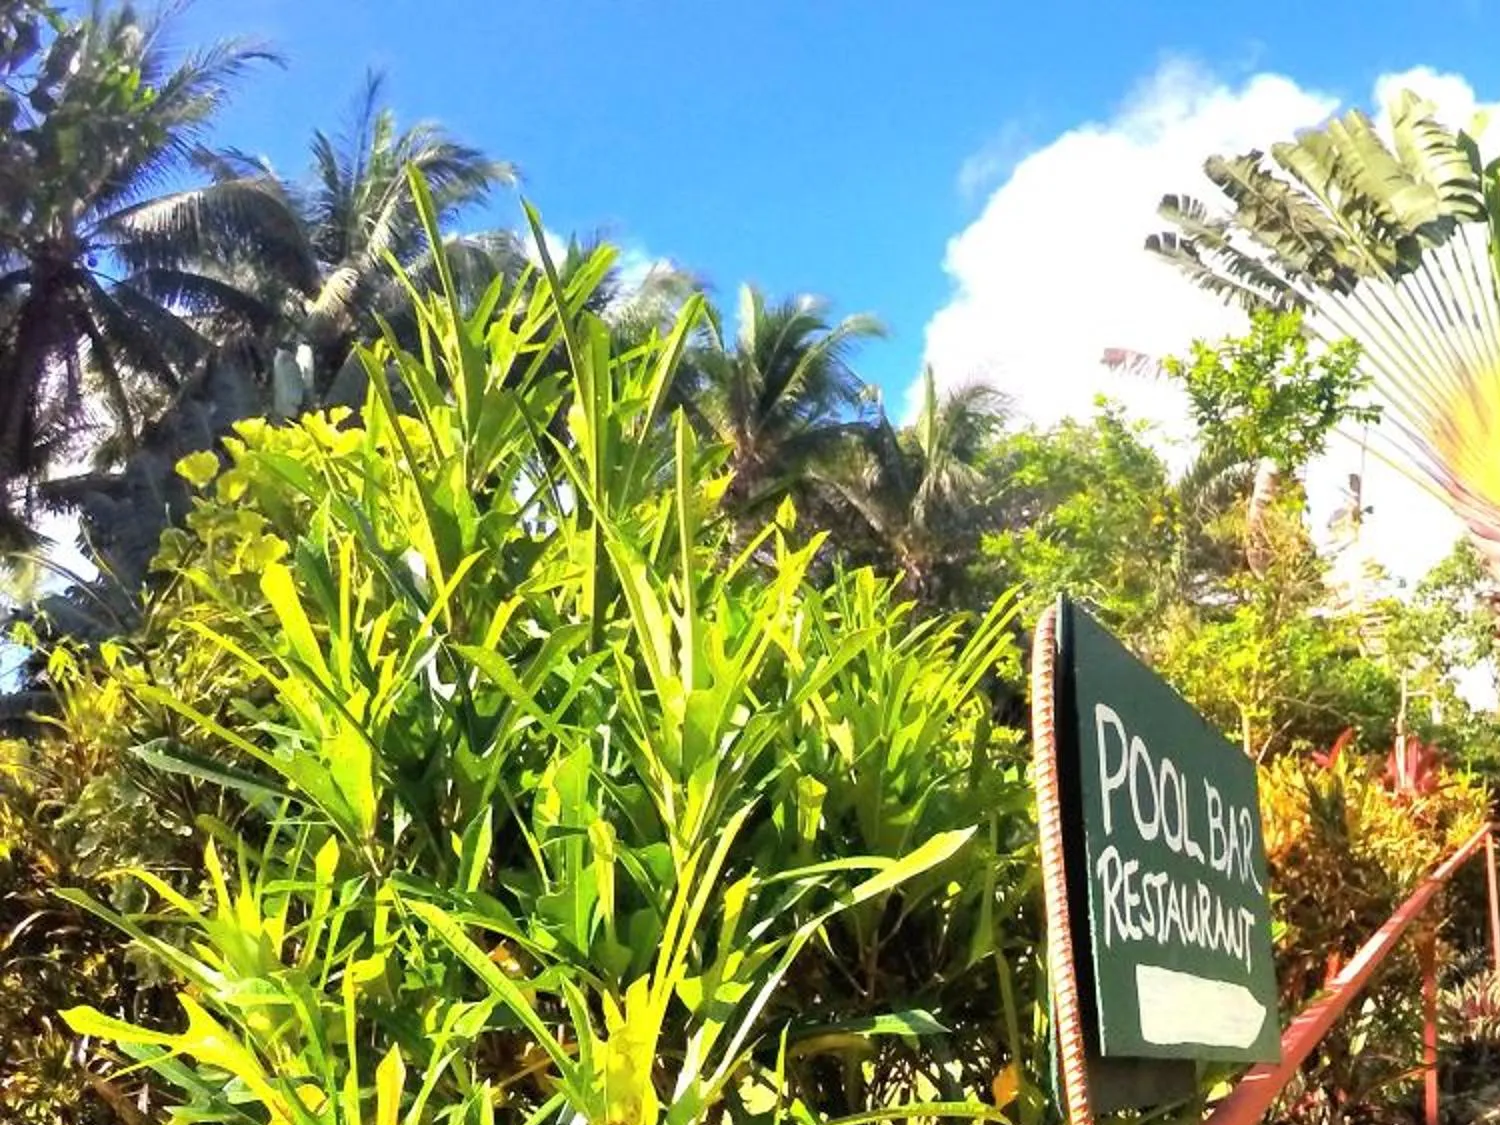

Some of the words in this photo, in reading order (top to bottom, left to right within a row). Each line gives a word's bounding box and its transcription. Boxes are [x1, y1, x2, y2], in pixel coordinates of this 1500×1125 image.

[1095, 702, 1205, 864] POOL
[1203, 776, 1263, 896] BAR
[1096, 844, 1255, 975] RESTAURANT
